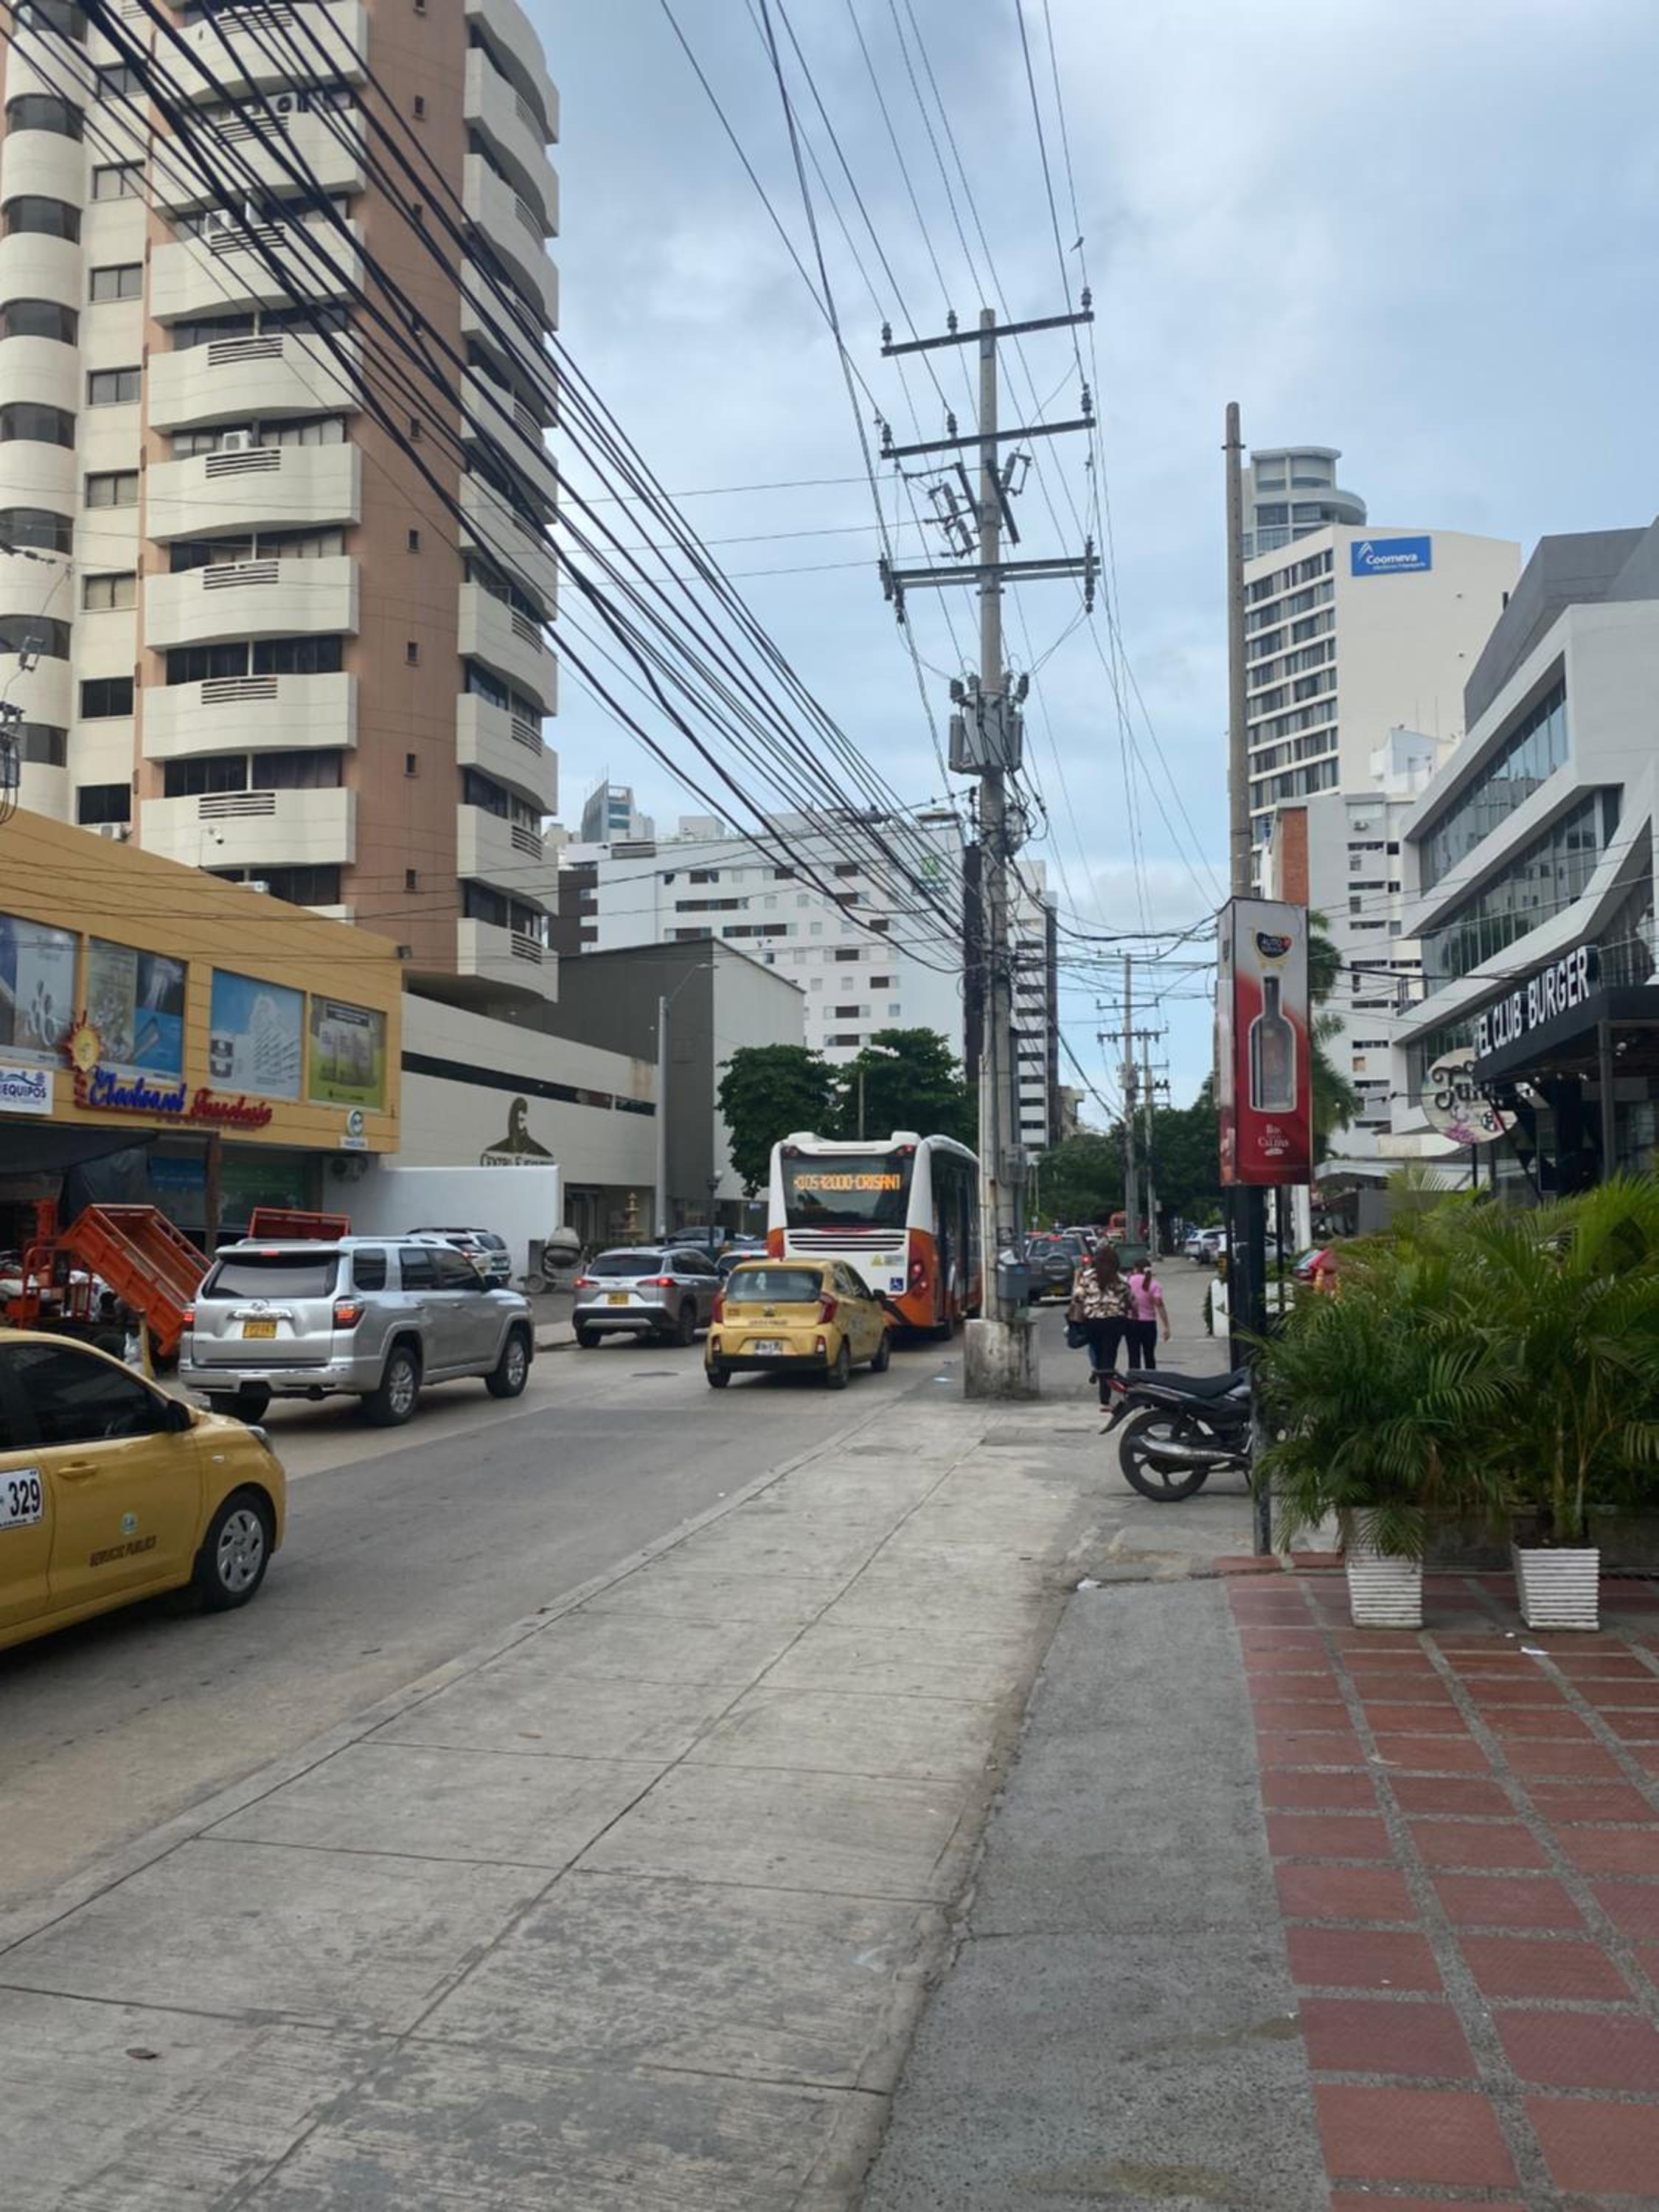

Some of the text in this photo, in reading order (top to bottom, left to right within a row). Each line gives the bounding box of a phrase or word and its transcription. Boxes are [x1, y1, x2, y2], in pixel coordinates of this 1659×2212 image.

[1366, 554, 1417, 566] Coomeva
[1479, 945, 1590, 1058] EL CLUB BURGER
